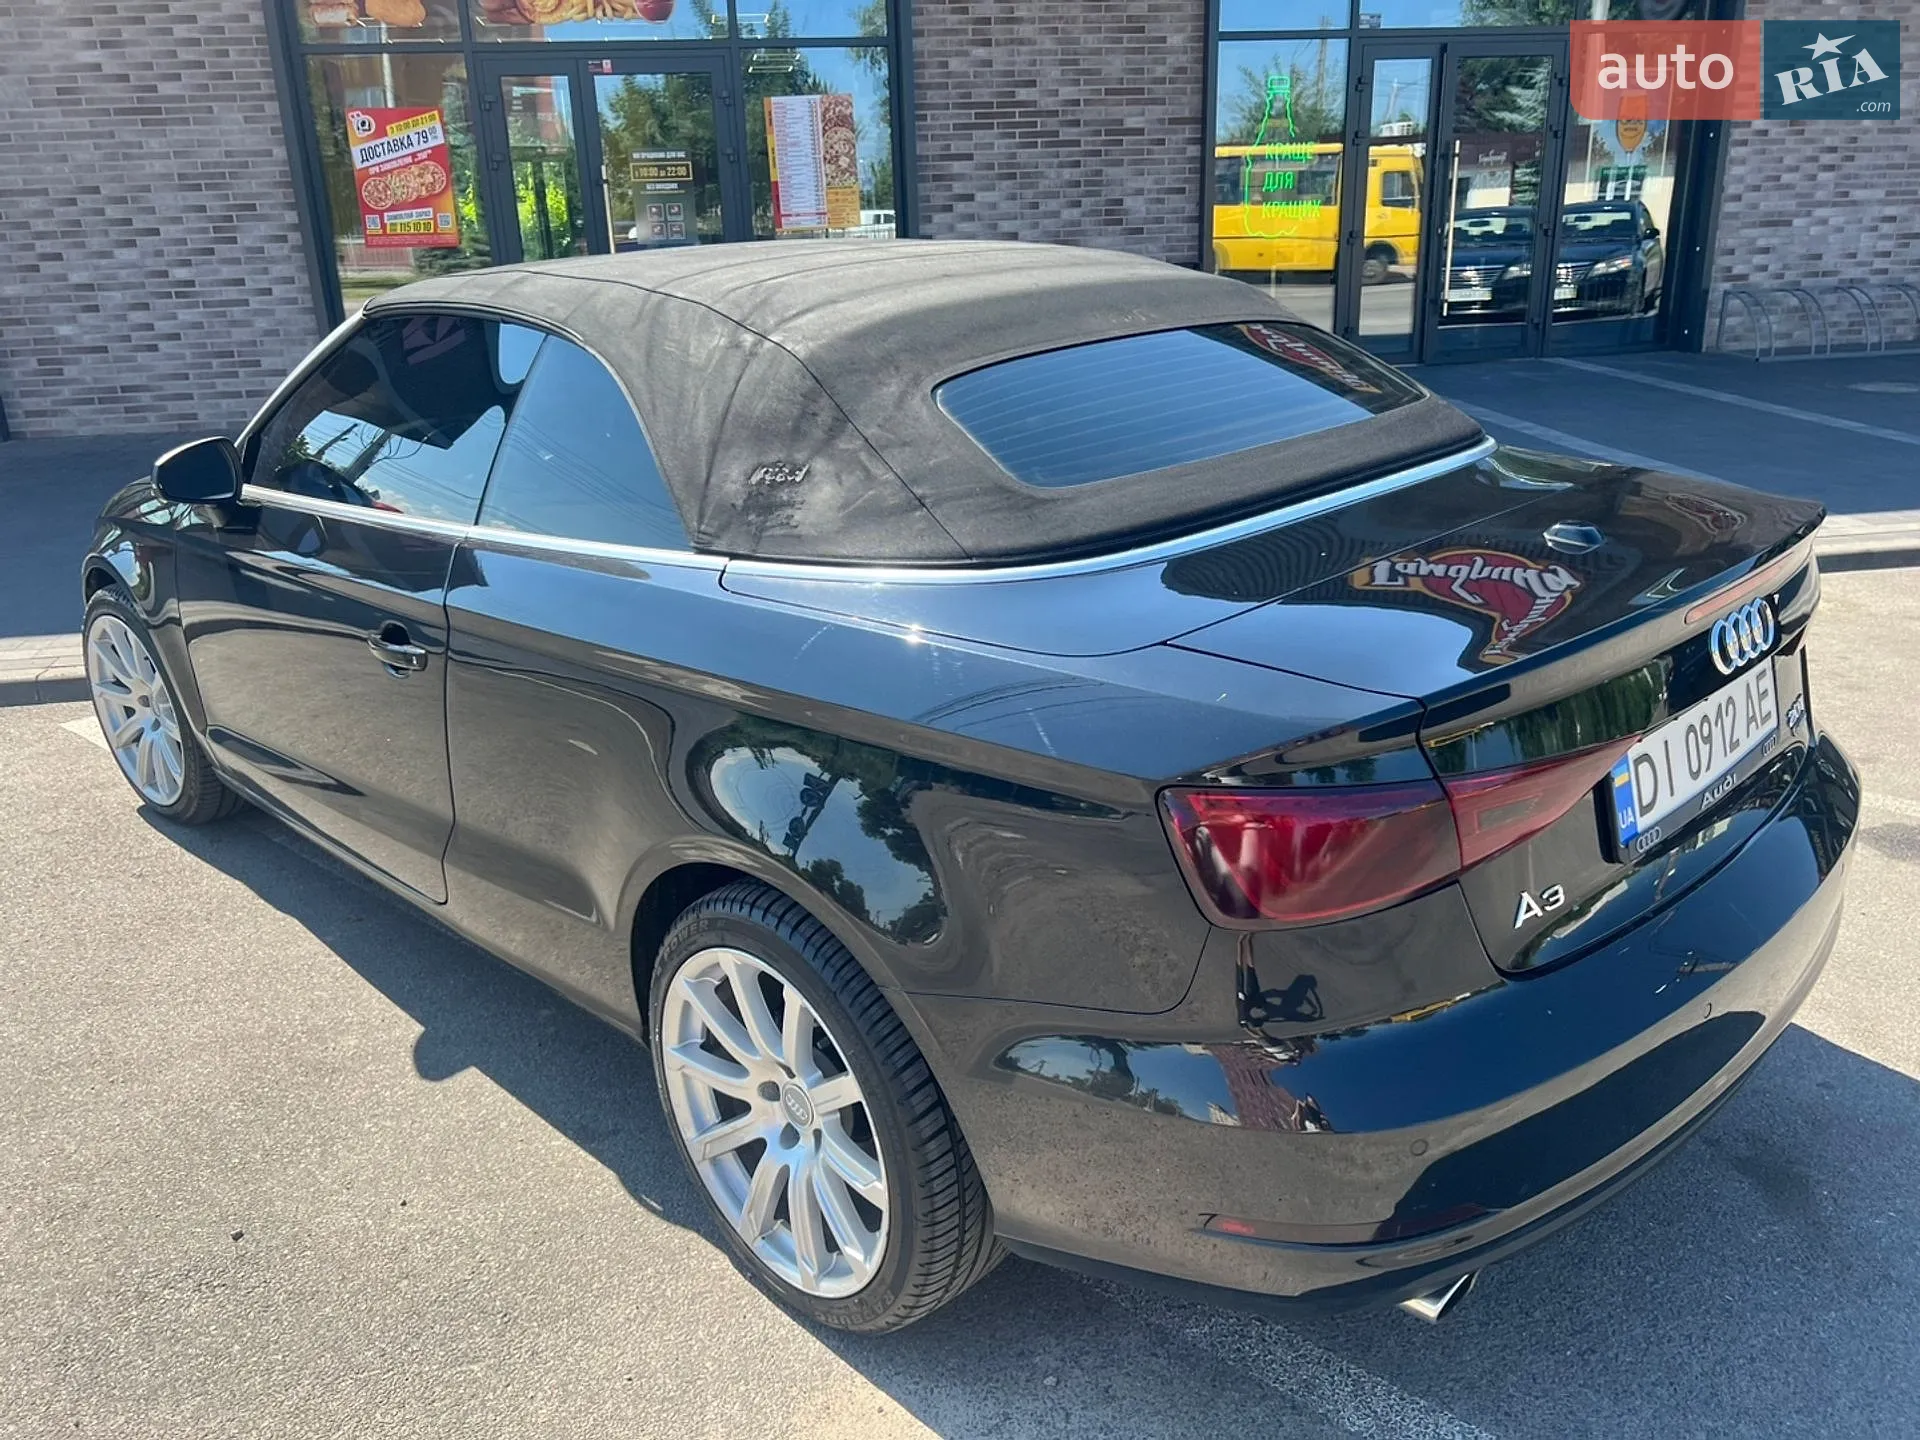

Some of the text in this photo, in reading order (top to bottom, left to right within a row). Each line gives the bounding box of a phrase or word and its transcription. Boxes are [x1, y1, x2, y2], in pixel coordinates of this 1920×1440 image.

[360, 134, 414, 164] ДОСТАВКА
[415, 129, 429, 148] 79
[1266, 142, 1315, 163] КРАЩЕ
[1263, 172, 1295, 192] ДЛЯ
[1262, 200, 1321, 220] КРАЩИХ
[1633, 669, 1771, 817] DI 0912 AE
[1701, 774, 1737, 811] Audi
[1619, 808, 1634, 829] UA
[1513, 884, 1565, 930] A3
